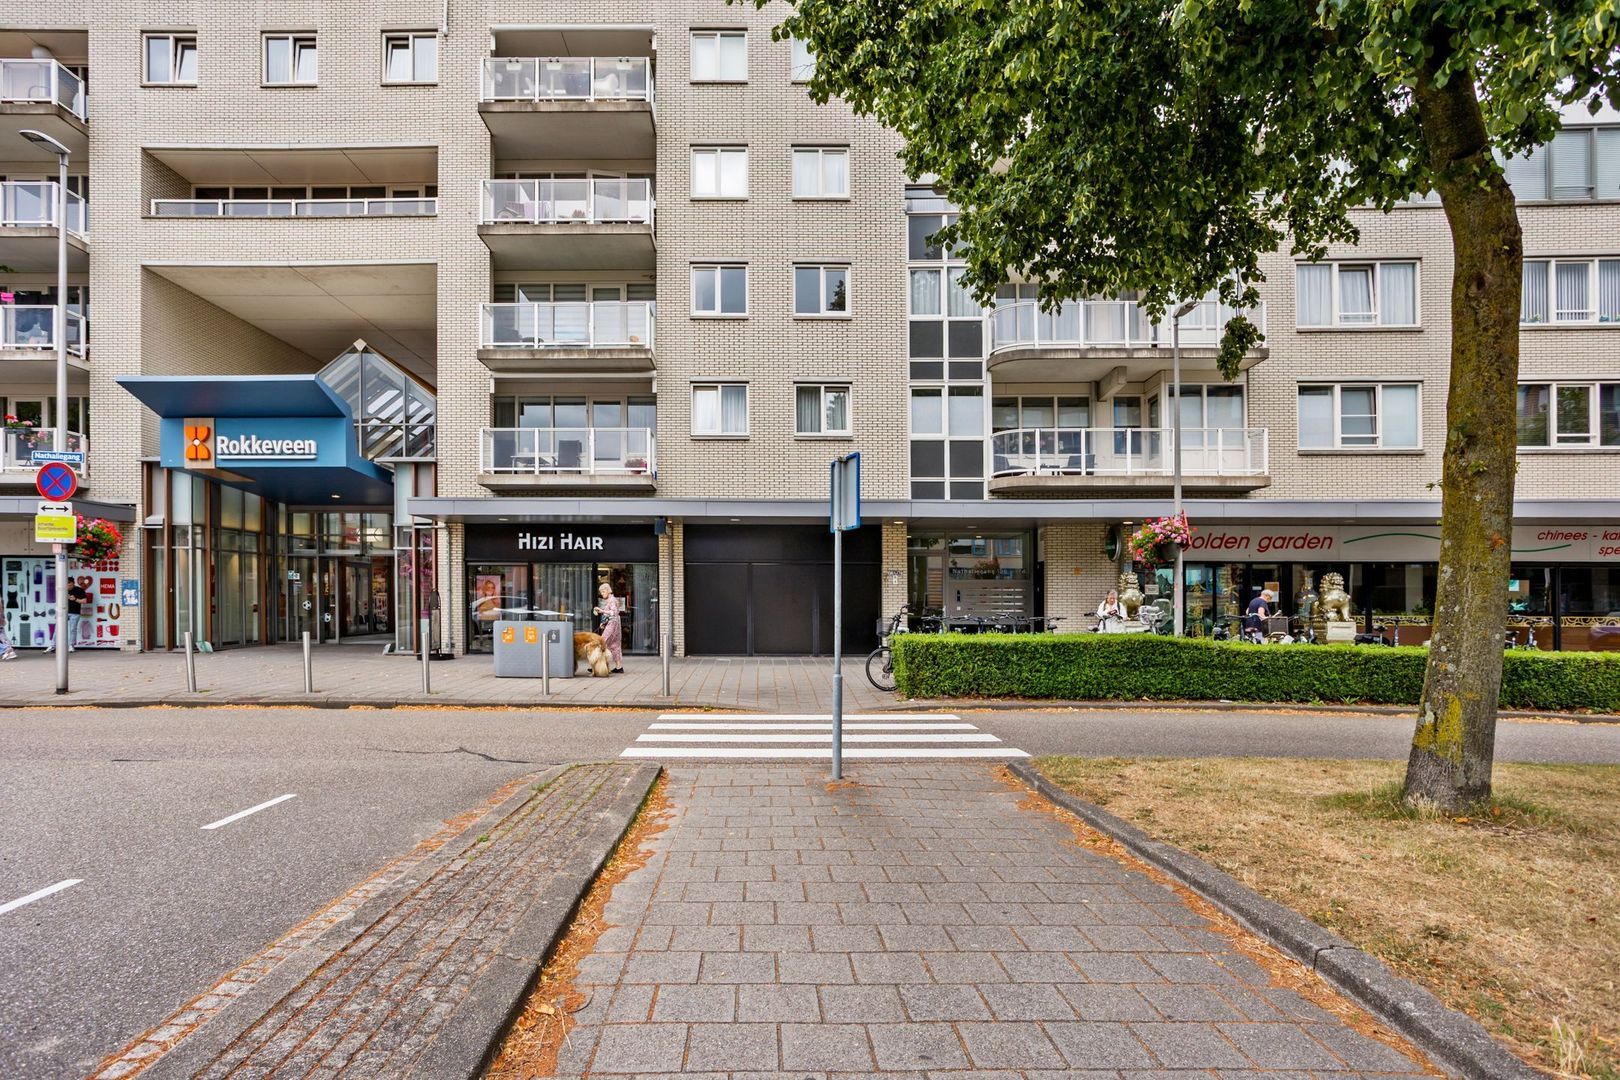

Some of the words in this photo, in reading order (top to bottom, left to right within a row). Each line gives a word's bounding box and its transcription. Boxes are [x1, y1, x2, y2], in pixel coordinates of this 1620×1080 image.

[216, 434, 318, 454] Rokkeveen
[518, 532, 554, 550] HIZI
[560, 533, 604, 550] HAIR
[1256, 532, 1334, 553] garden
[1537, 530, 1588, 541] chinees
